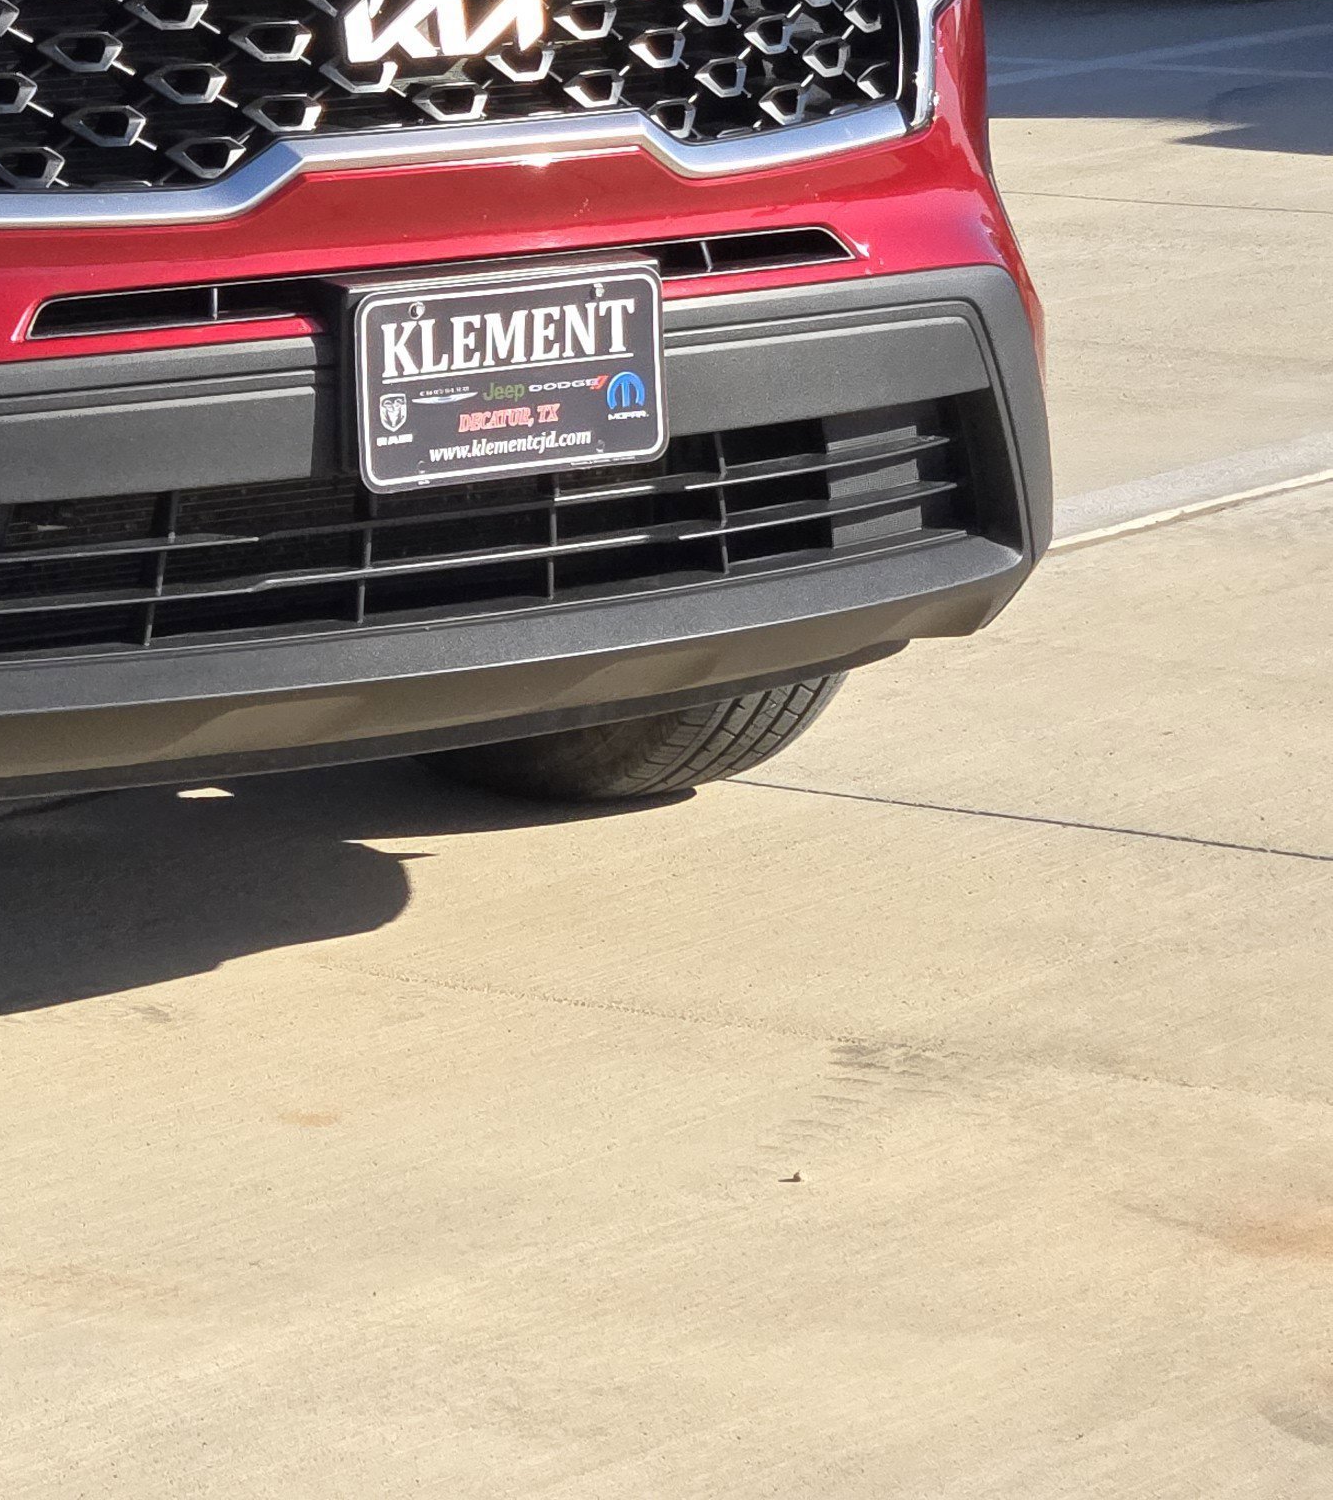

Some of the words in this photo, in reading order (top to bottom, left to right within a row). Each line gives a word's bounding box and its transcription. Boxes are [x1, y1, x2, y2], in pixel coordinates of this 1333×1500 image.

[381, 298, 635, 378] KLEMENT
[483, 382, 526, 403] Jeep
[528, 378, 599, 393] DODGE
[458, 407, 534, 433] DECATUR,
[537, 403, 561, 423] TX
[429, 430, 592, 463] www.klementcjd.com
